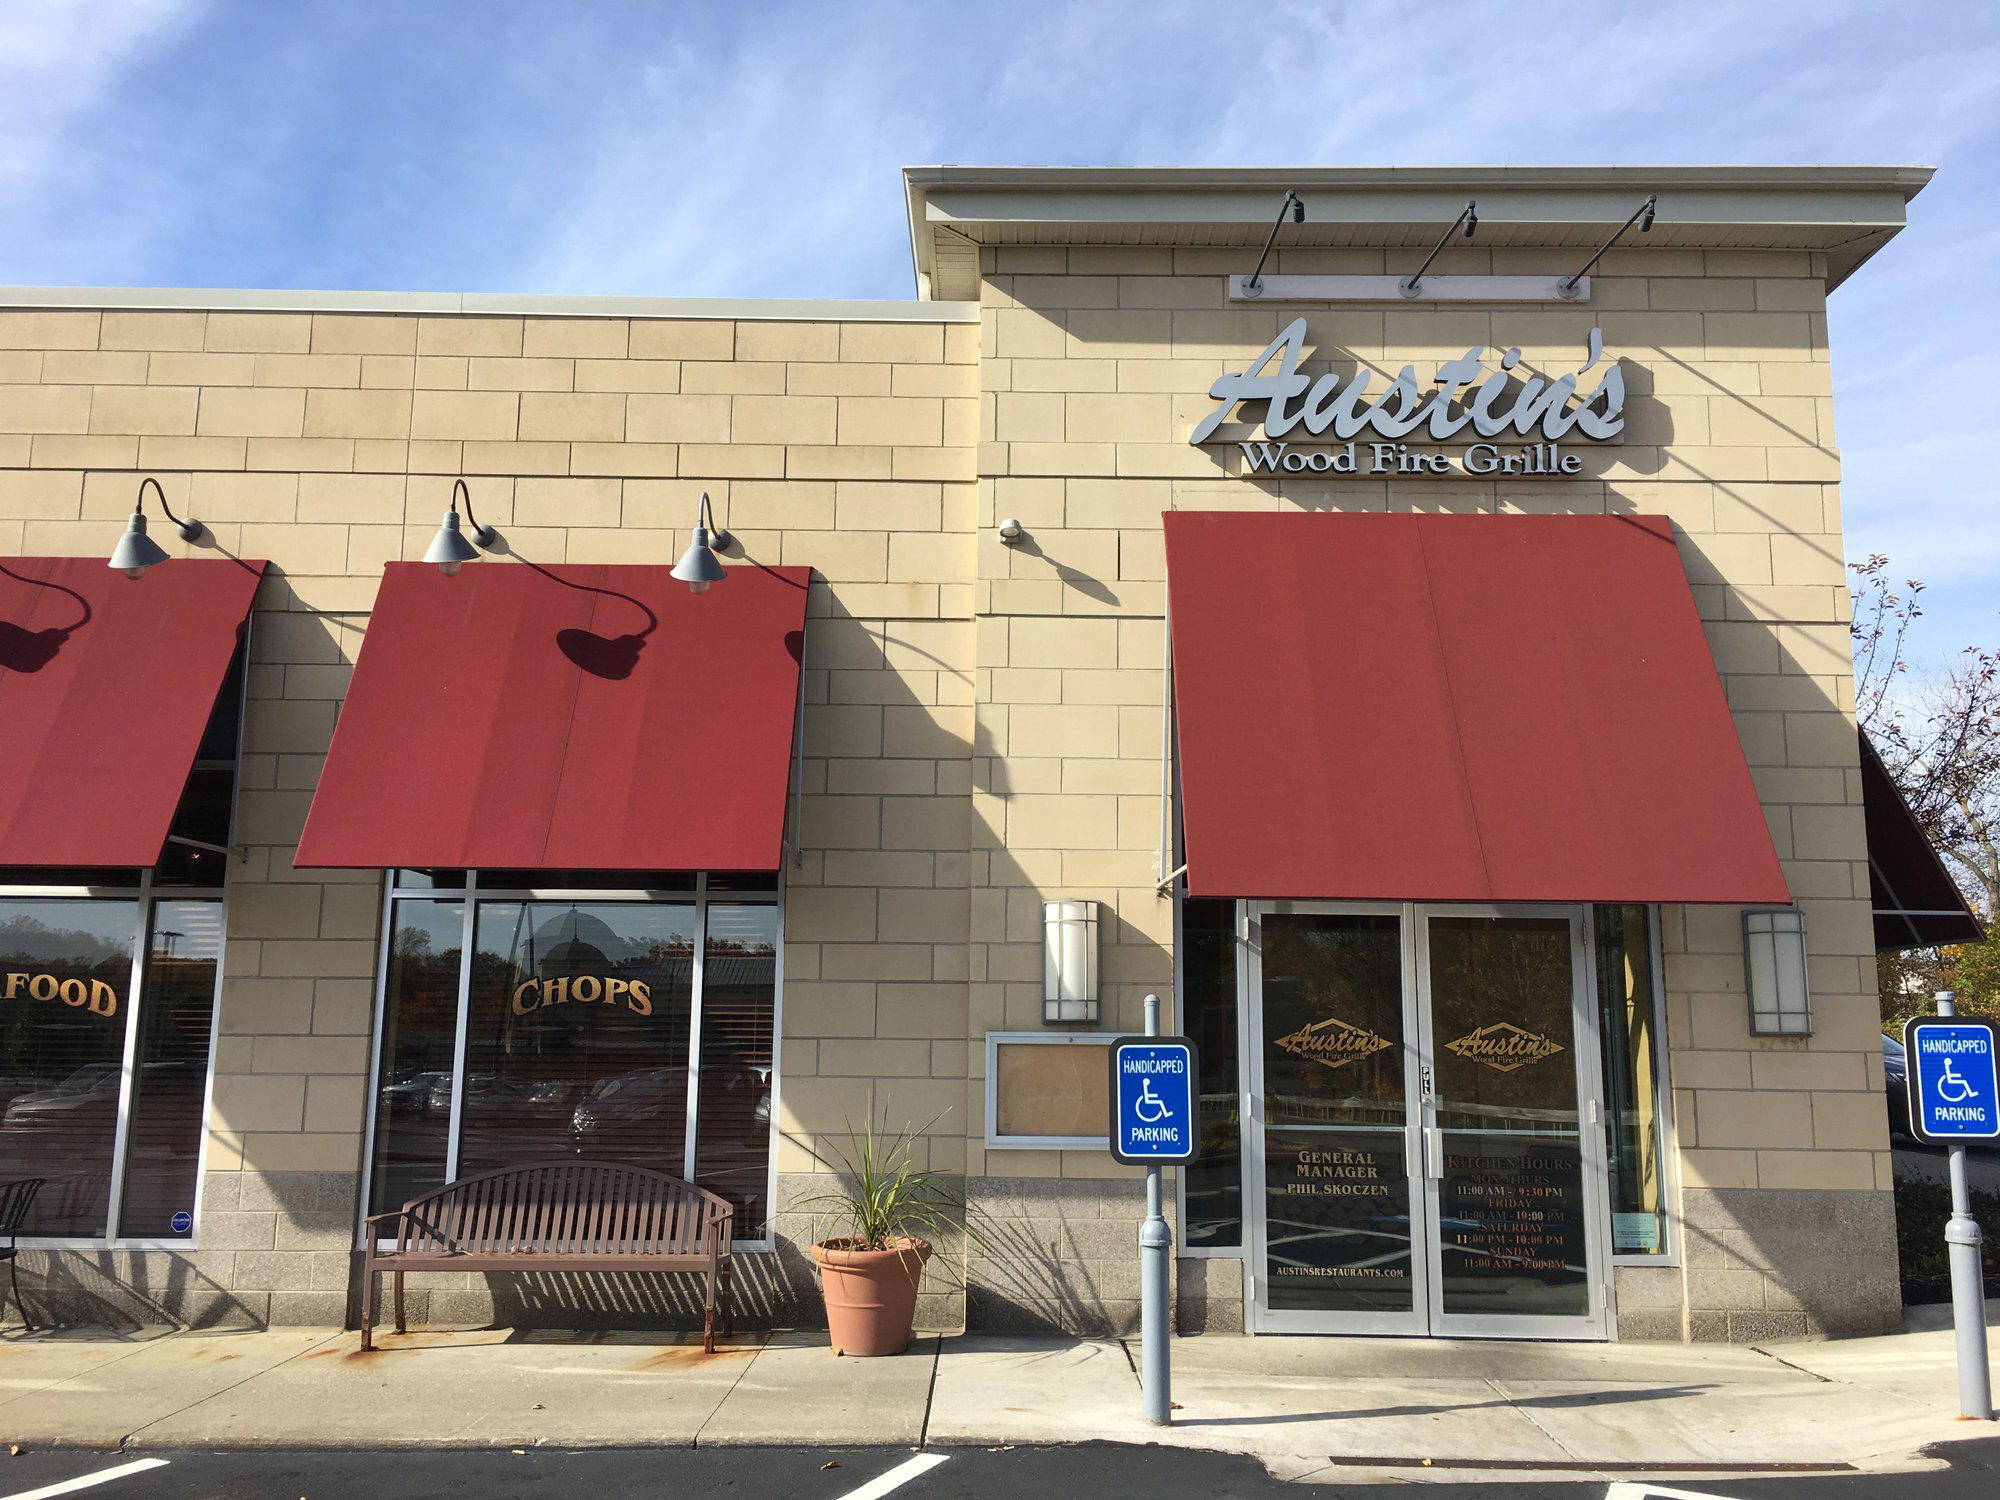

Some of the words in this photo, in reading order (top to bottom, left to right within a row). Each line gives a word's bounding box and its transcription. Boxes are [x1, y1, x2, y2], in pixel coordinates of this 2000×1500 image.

[1190, 317, 1625, 445] Austin's
[1238, 442, 1357, 474] Wood
[1369, 443, 1450, 474] Fire
[1463, 443, 1582, 475] Grille
[0, 972, 117, 1018] FOOD
[512, 975, 653, 1016] CHOPS
[1286, 1023, 1380, 1053] Austin's
[1456, 1026, 1552, 1057] Austin's
[1922, 1039, 1988, 1054] HANDICAPPED
[1301, 1051, 1324, 1060] Wood
[1326, 1051, 1342, 1060] Fire
[1343, 1051, 1367, 1060] Grille
[1471, 1055, 1495, 1064] Wood
[1497, 1055, 1514, 1064] Fire
[1515, 1055, 1539, 1065] Grille
[1123, 1059, 1184, 1074] HANDICAPPED
[1422, 1067, 1430, 1095] PULL
[1934, 1107, 1986, 1122] PARKING
[1131, 1127, 1179, 1142] PARKING
[1298, 1150, 1376, 1165] GENERAL
[1447, 1155, 1516, 1169] KITCHEN
[1520, 1156, 1573, 1170] HOURS
[1296, 1164, 1378, 1179] MANAGER
[1287, 1183, 1319, 1195] PHIL
[1323, 1184, 1389, 1196] SKOCZEN
[1457, 1185, 1484, 1195] 11:00
[1485, 1186, 1505, 1196] AM
[1518, 1187, 1543, 1197] 9:30
[1545, 1187, 1563, 1198] PM
[1488, 1198, 1532, 1208] FRIDAY
[1459, 1210, 1485, 1220] 11:00
[1488, 1210, 1506, 1220] AM
[1516, 1211, 1544, 1221] 10:00
[1480, 1223, 1543, 1233] SATURDAY
[1457, 1234, 1484, 1244] 11:00
[1515, 1235, 1543, 1245] 10:00
[1546, 1235, 1564, 1245] PM
[1489, 1247, 1537, 1257] SUNDAY
[1464, 1258, 1490, 1268] 11:00
[1493, 1259, 1512, 1269] AM
[1276, 1266, 1404, 1278] AUSTINSRESTAURANTS.COM
